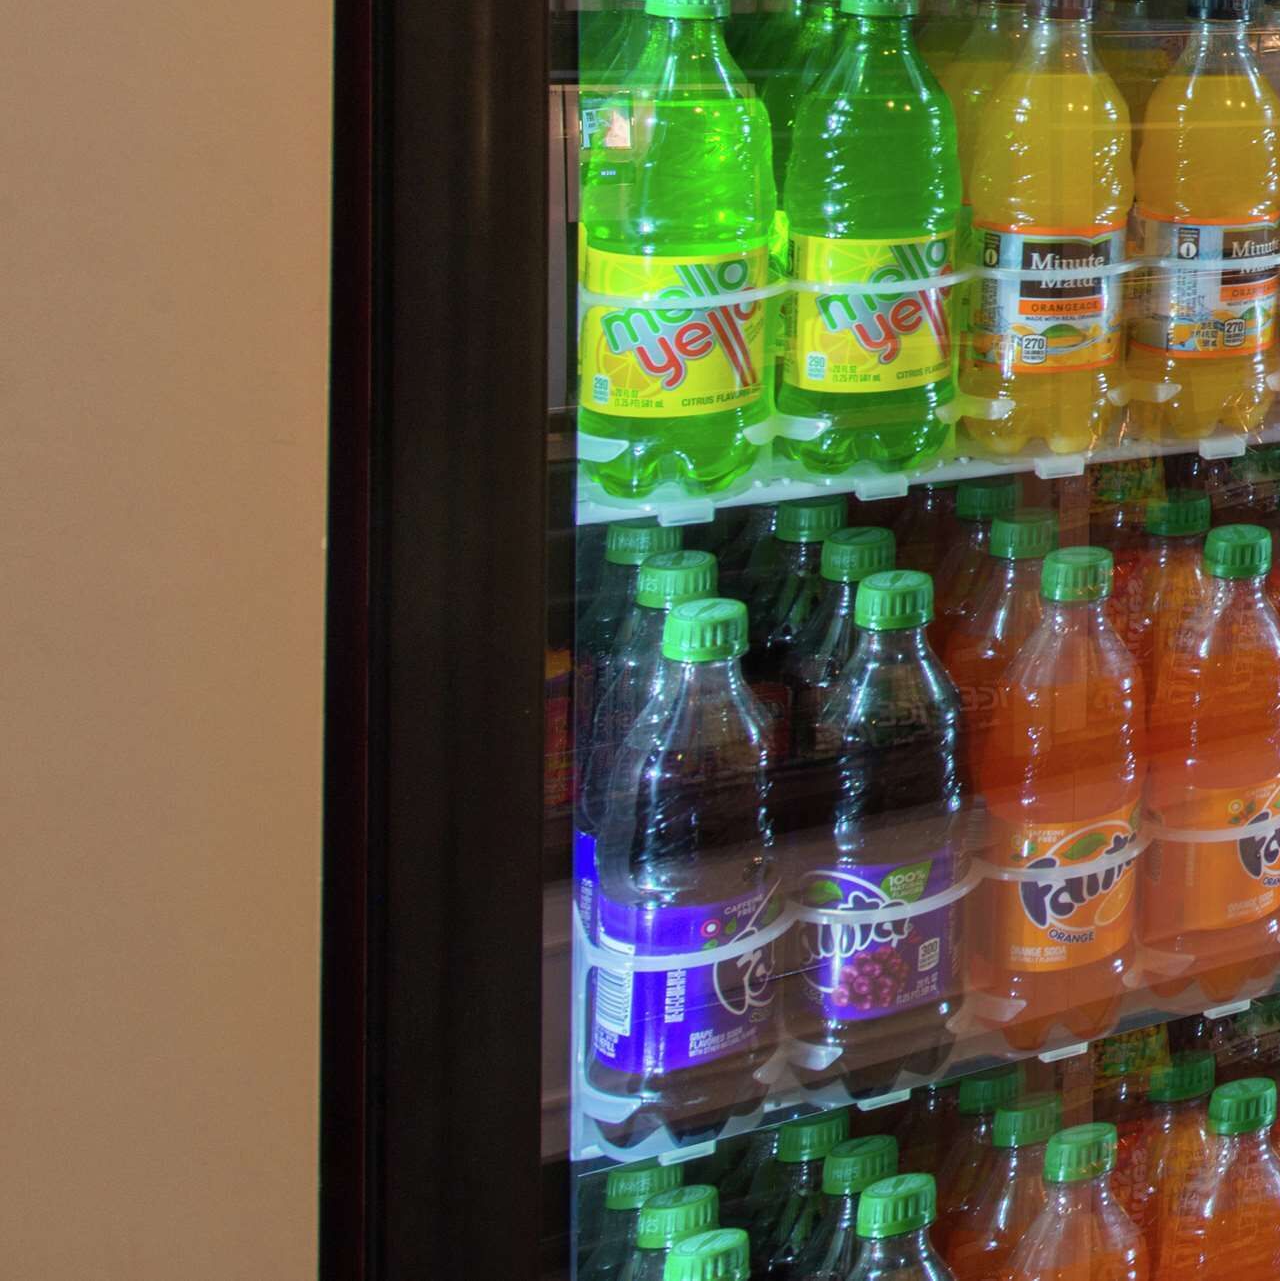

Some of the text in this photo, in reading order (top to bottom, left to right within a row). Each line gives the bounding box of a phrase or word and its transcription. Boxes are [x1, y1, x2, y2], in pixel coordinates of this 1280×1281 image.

[1030, 252, 1105, 271] Minute
[815, 238, 949, 331] mello
[600, 256, 750, 355] mello
[1031, 300, 1098, 312] ORANGEADE
[1226, 321, 1243, 333] 270
[634, 285, 763, 392] yello
[1024, 337, 1045, 350] 270
[895, 367, 924, 381] CITRUS
[681, 396, 714, 407] CITRUS
[888, 871, 926, 885] 100%
[1048, 928, 1095, 943] ORANGE
